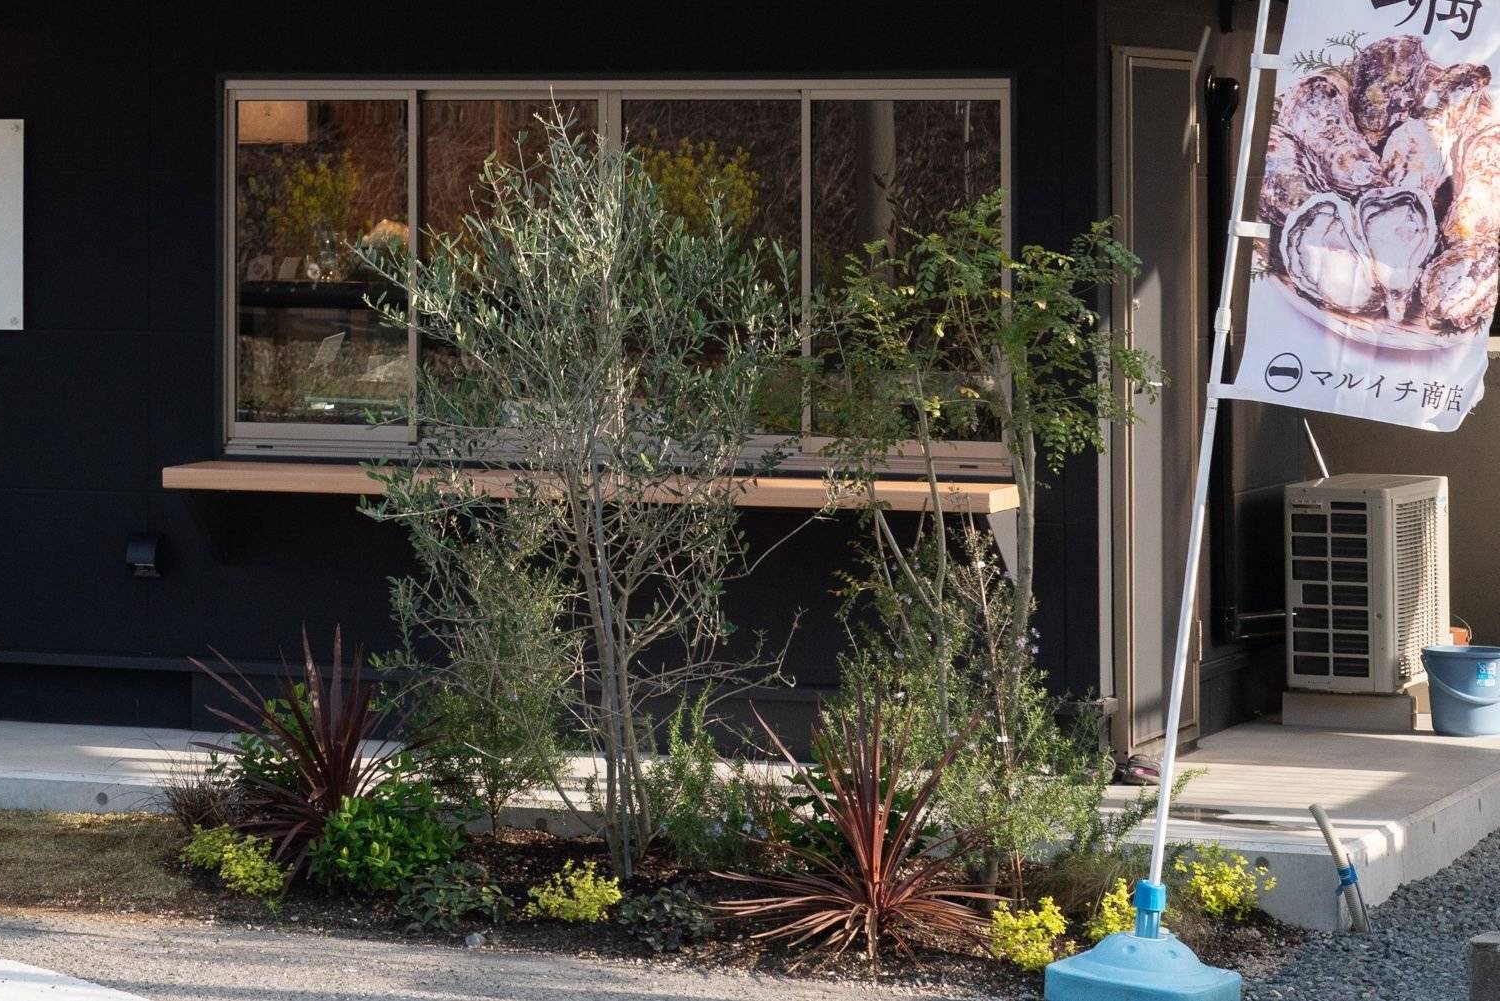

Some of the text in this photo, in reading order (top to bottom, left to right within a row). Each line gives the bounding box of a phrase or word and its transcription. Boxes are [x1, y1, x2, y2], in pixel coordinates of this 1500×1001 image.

[1310, 370, 1464, 411] マルイチ商店
